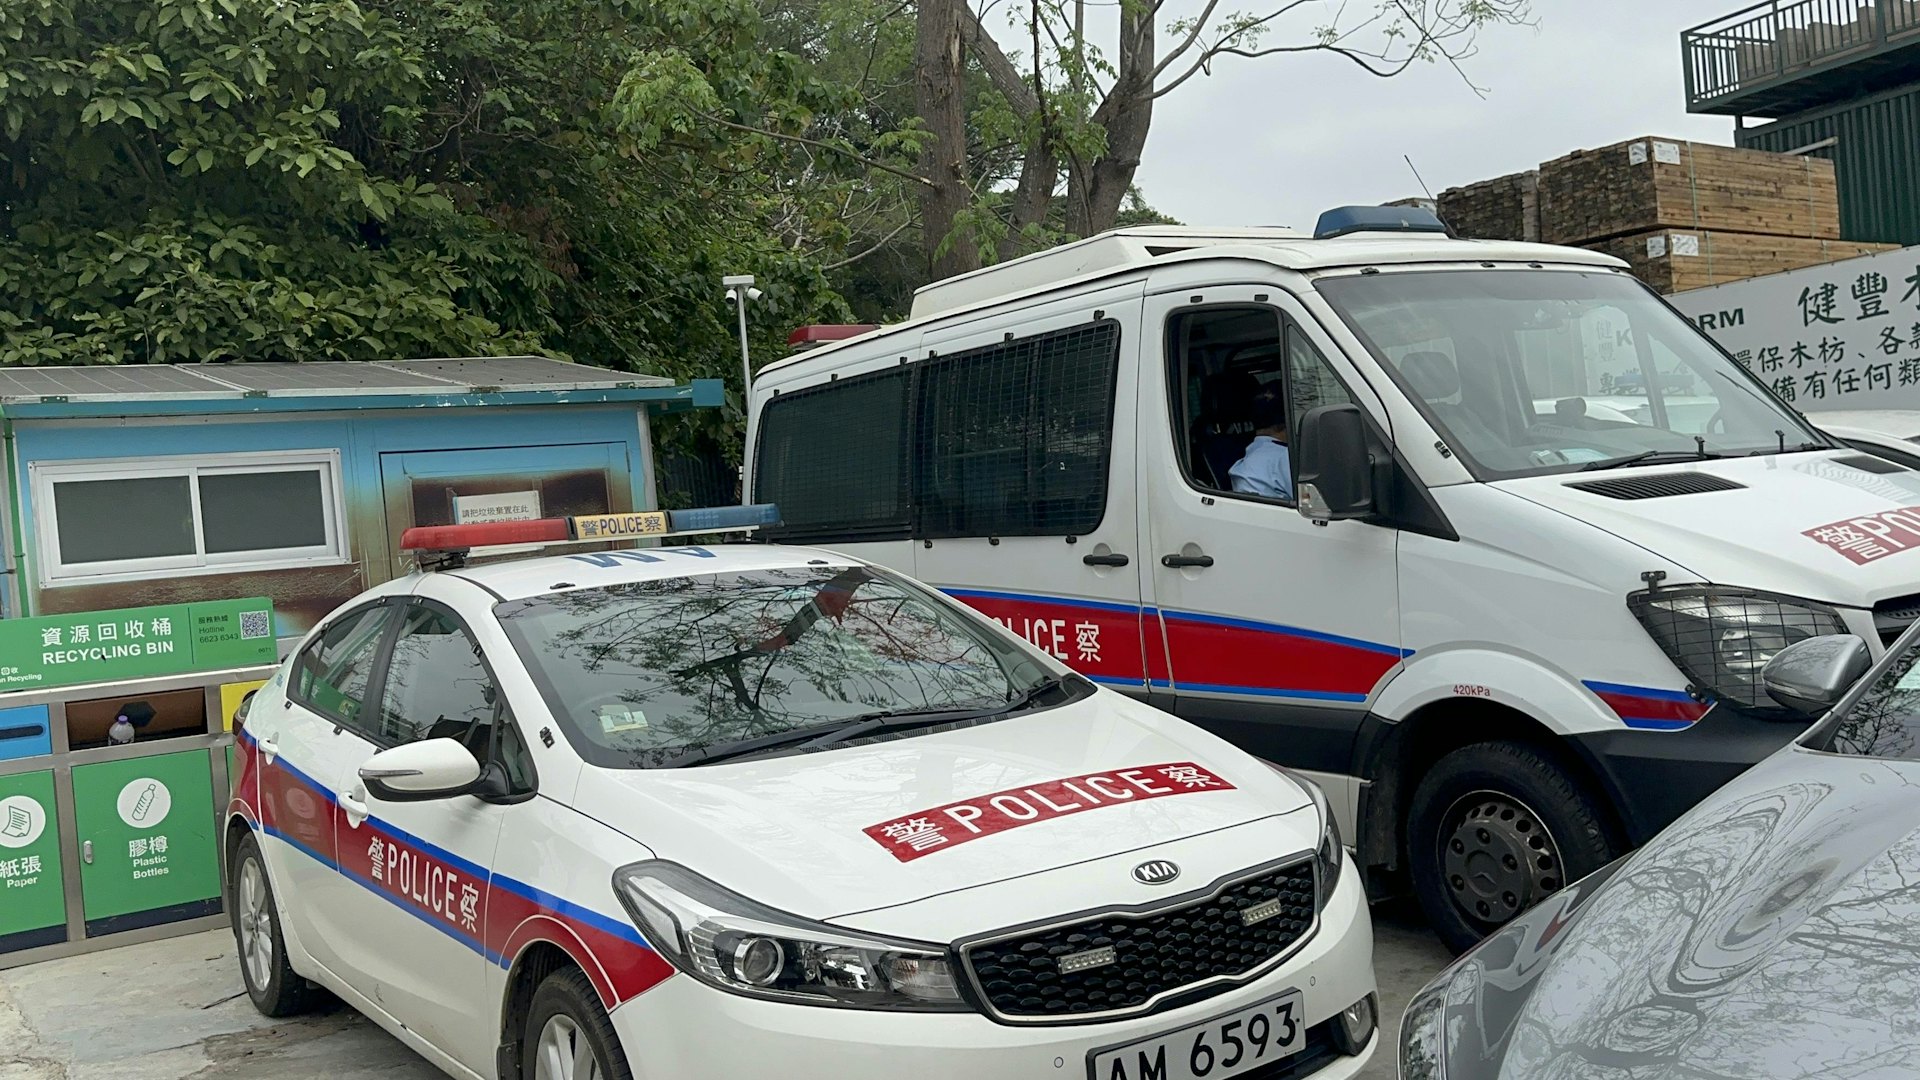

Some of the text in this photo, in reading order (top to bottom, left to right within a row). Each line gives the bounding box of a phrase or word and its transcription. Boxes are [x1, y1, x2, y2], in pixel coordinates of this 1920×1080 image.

[1688, 308, 1744, 331] RM
[41, 617, 173, 648] 資源回收桶
[198, 626, 225, 635] Hotline
[43, 641, 174, 665] RECYCLING BIN
[7, 673, 43, 683] Recycling
[1453, 684, 1491, 697] 420kPa
[128, 835, 169, 858] 膠樽
[0, 855, 42, 879] 紙張
[133, 855, 168, 867] Plastic
[133, 866, 169, 879] Bottles
[1137, 862, 1177, 881] KIA
[6, 876, 38, 888] Paper
[1109, 1001, 1297, 1080] AM 6593
